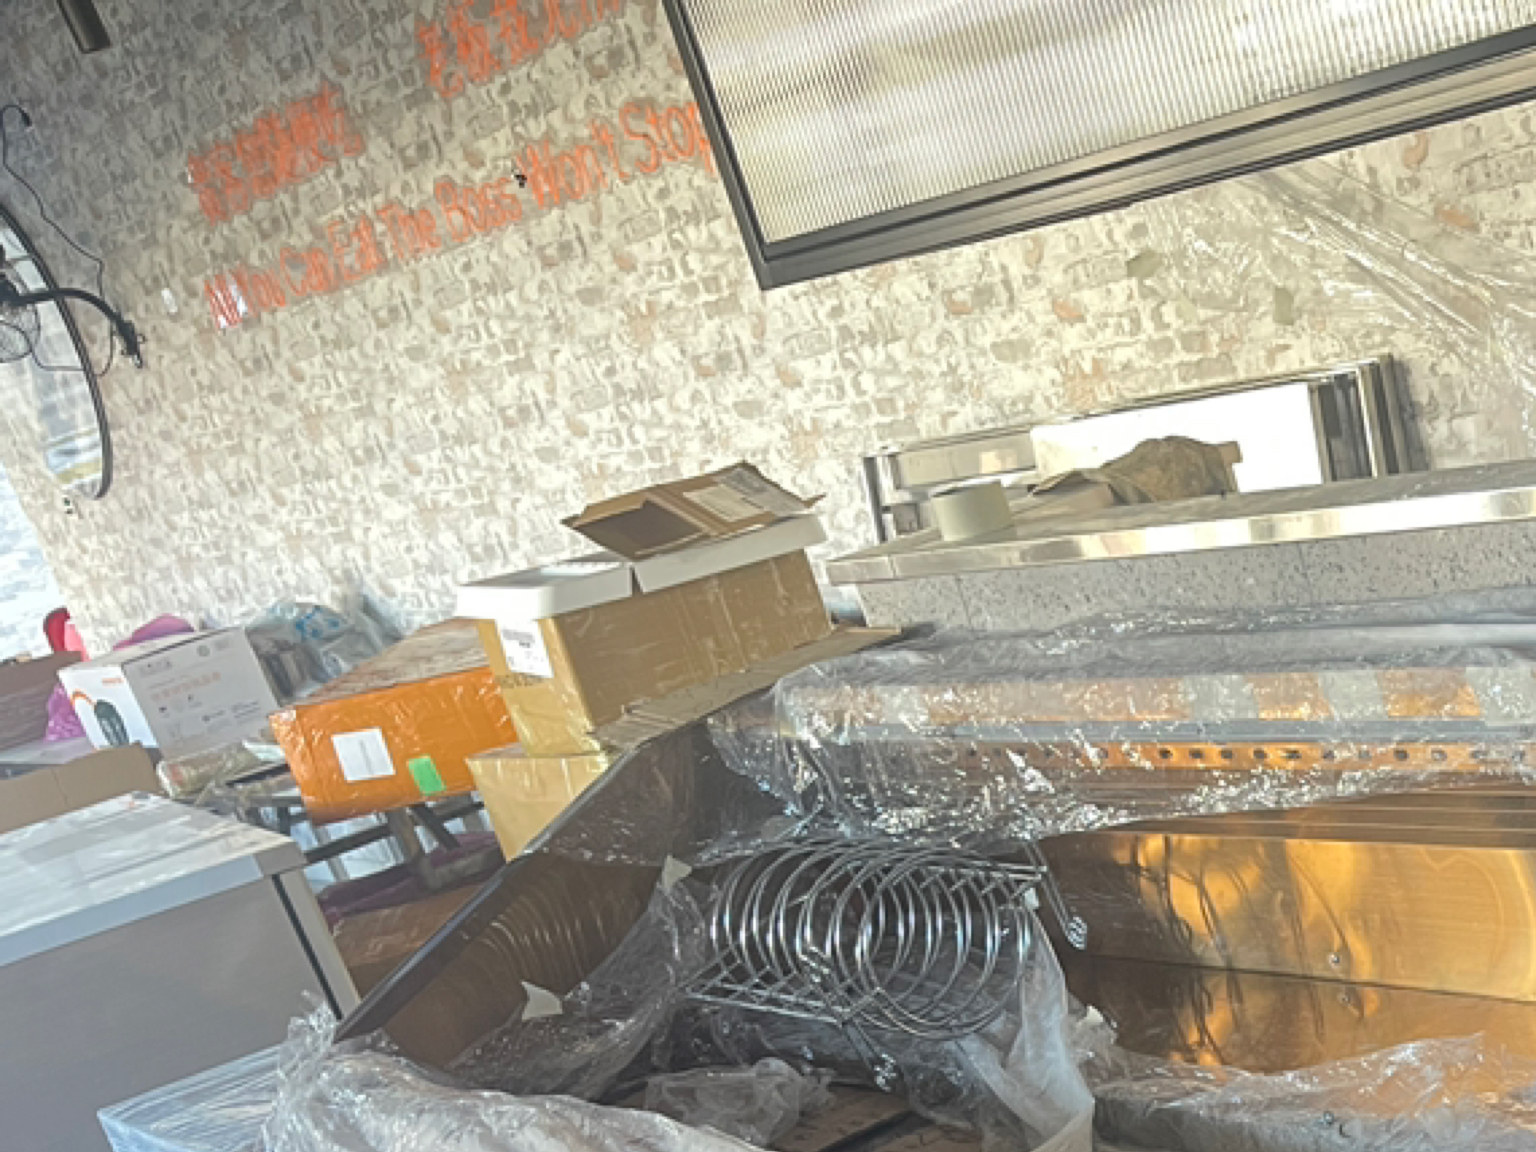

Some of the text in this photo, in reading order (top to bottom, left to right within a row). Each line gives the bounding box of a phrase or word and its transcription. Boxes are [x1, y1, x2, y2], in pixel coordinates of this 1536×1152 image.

[230, 264, 287, 318] You
[279, 247, 337, 297] Can
[326, 213, 383, 282] Eat
[376, 203, 442, 259] The
[434, 176, 522, 242] Boss
[515, 116, 630, 210] Won't
